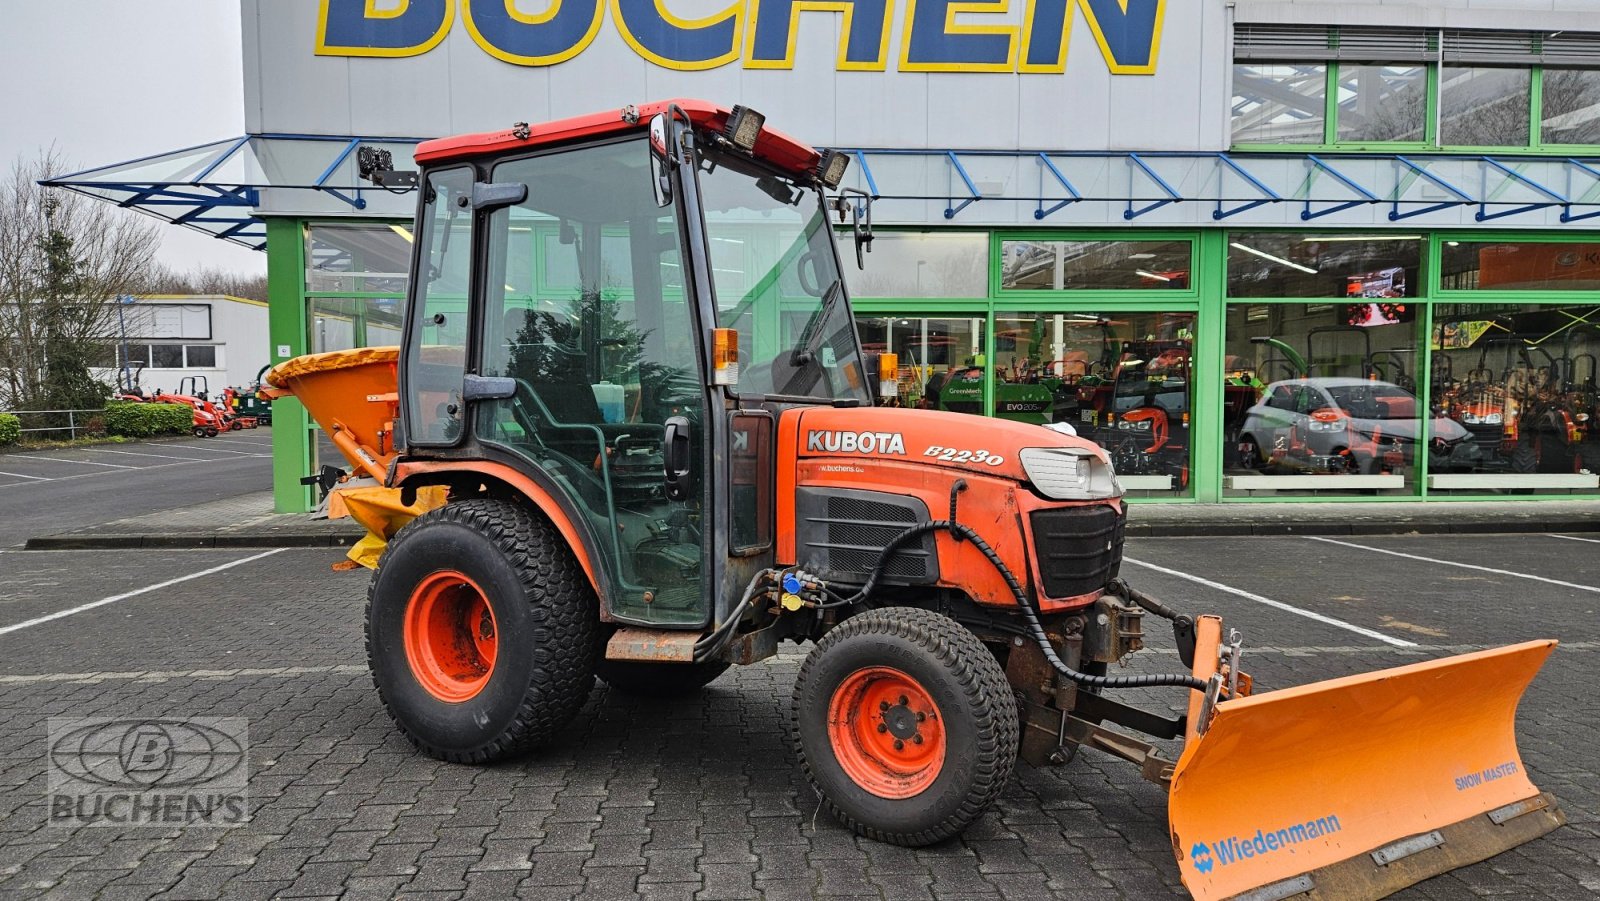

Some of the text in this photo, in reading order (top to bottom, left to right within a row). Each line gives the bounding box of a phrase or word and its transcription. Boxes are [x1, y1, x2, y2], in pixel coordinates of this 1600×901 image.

[1007, 403, 1023, 411] EVO
[807, 430, 1004, 467] KUBOTA B2230
[1454, 761, 1518, 791] SNOW MASTER
[1213, 814, 1342, 866] Wiedenmann
